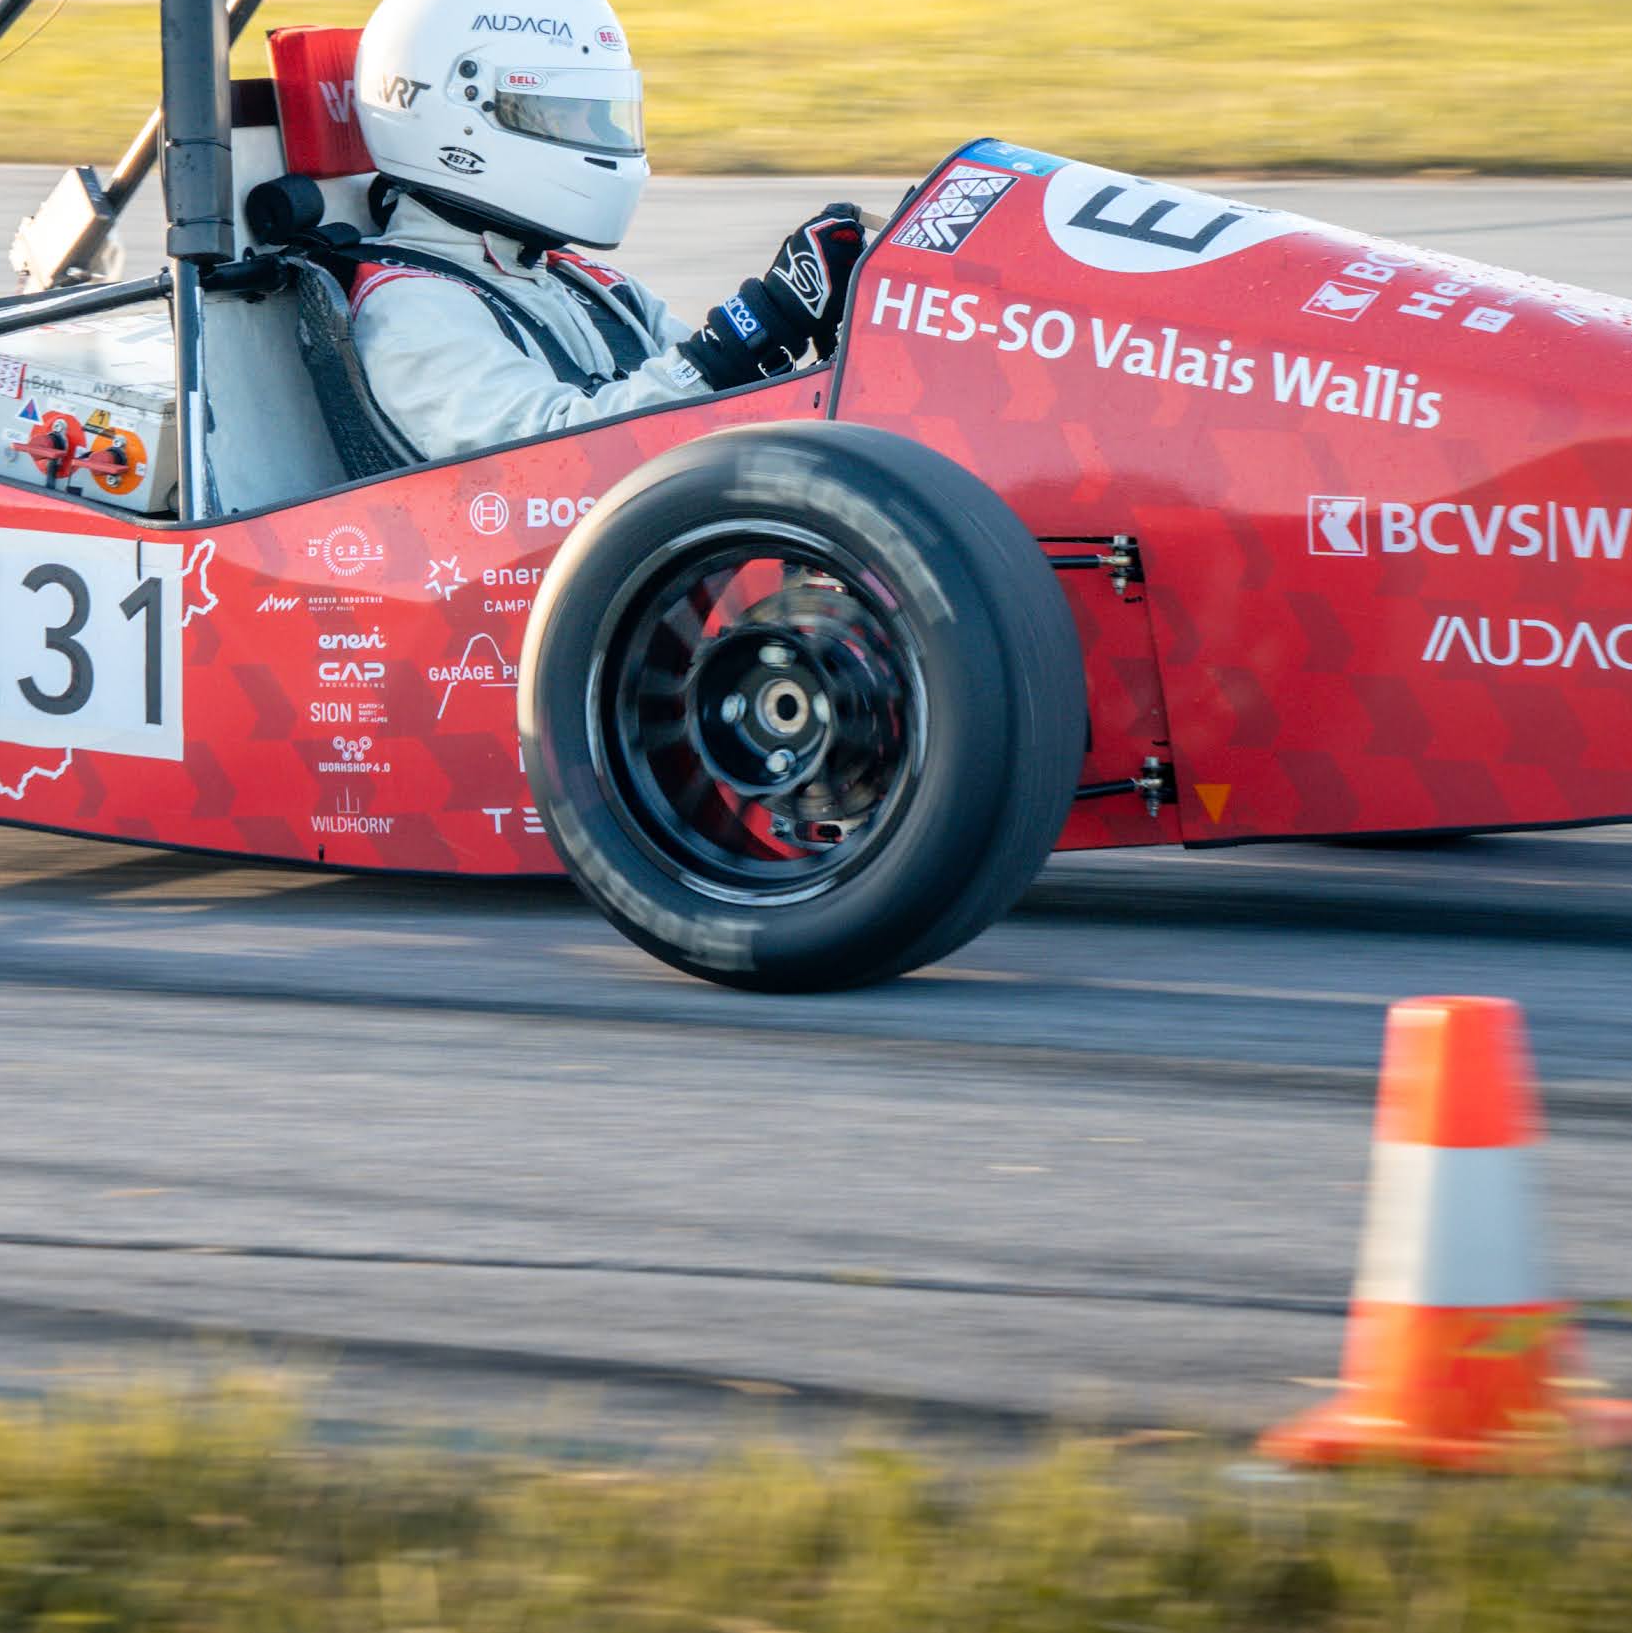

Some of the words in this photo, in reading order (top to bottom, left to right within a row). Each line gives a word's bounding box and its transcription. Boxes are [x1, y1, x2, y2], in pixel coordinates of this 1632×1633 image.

[471, 15, 573, 39] AUDACIA
[509, 75, 538, 85] BELL
[1066, 184, 1245, 254] E
[870, 278, 1077, 360] HES-SO
[1090, 316, 1255, 395] Valais
[1272, 351, 1443, 429] Wallis
[482, 568, 548, 585] ener
[318, 662, 385, 681] GAP
[428, 665, 495, 682] GARAGE
[310, 702, 352, 723] SION
